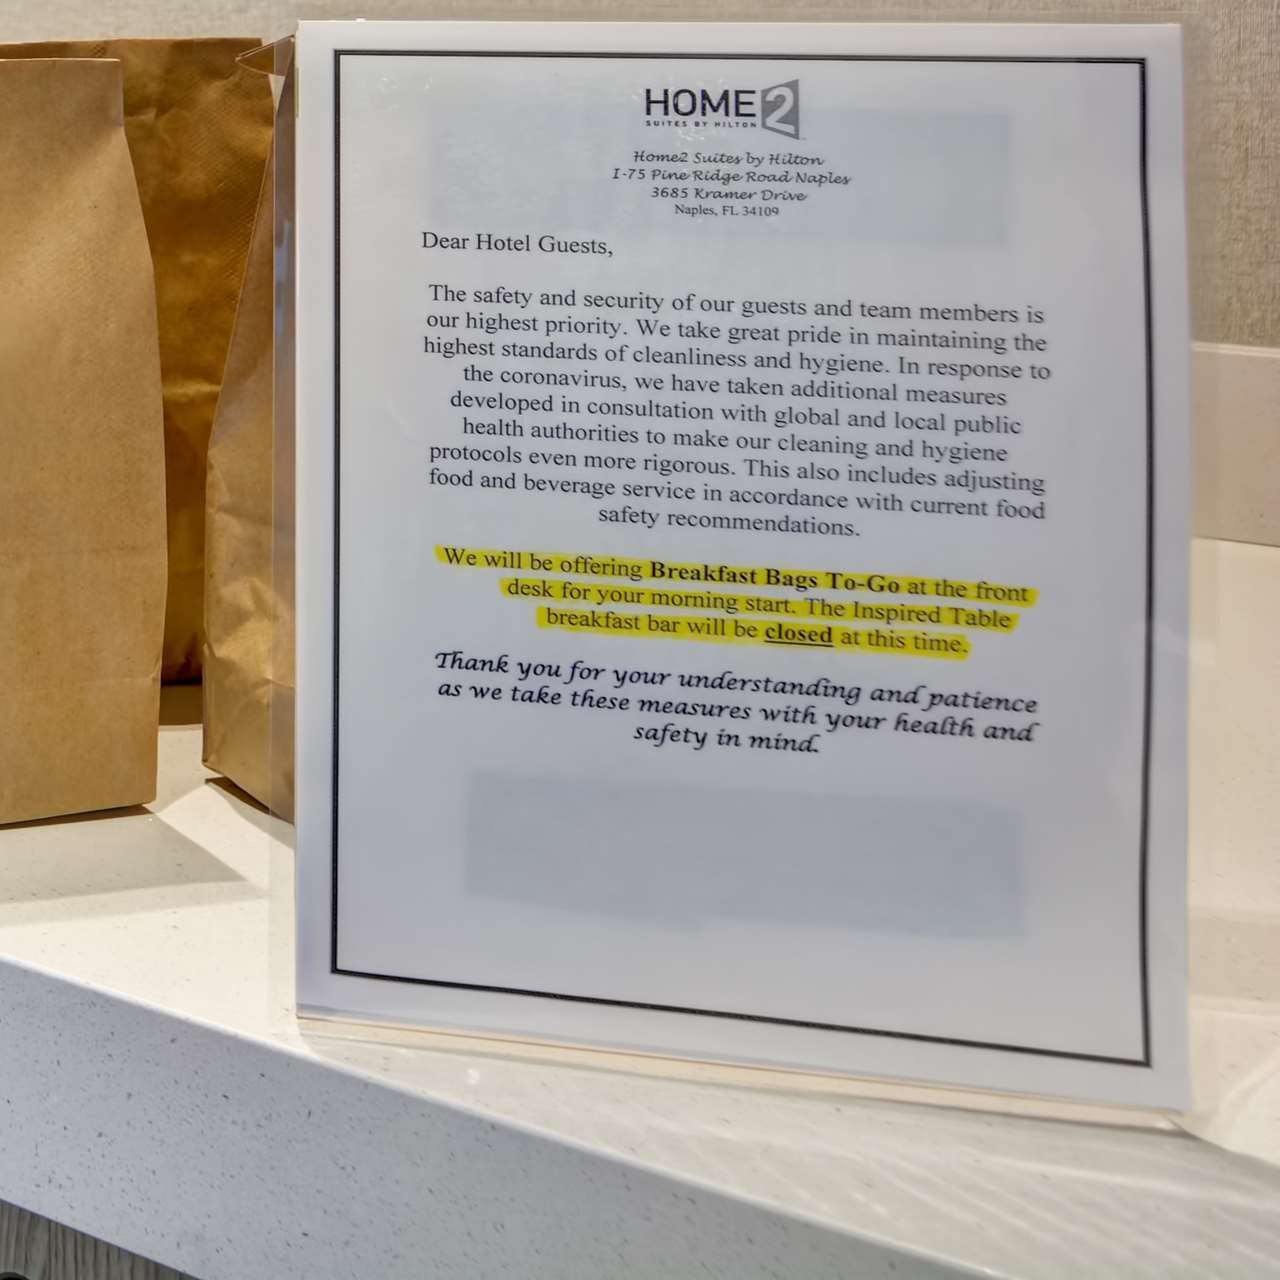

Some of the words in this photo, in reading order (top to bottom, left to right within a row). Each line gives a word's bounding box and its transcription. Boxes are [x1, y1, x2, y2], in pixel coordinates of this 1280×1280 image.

[645, 120, 687, 128] SUITES
[694, 120, 708, 128] BY
[714, 121, 757, 129] HILTON
[612, 167, 646, 180] I-75
[651, 169, 690, 181] Pine
[693, 170, 743, 184] Ridge
[745, 170, 794, 183] Road
[795, 171, 851, 187] Naples
[633, 150, 688, 163] Home2
[692, 152, 744, 165] Suites
[745, 152, 765, 168] by
[769, 153, 825, 166] Hilton
[651, 186, 688, 199] 3685
[693, 187, 757, 200] Kramer
[760, 189, 807, 201] Drive
[675, 204, 718, 217] Naples,
[722, 205, 739, 216] FL
[742, 206, 779, 216] 34109
[422, 231, 470, 250] Dear
[475, 233, 531, 252] Hotel
[538, 235, 613, 258] Guests,
[428, 284, 467, 302] The
[473, 286, 533, 309] safety
[539, 289, 577, 307] and
[583, 291, 664, 314] security
[672, 293, 696, 311] of
[699, 299, 736, 312] our
[741, 300, 807, 318] guests
[814, 299, 852, 317] and
[859, 303, 912, 319] team
[920, 304, 1019, 323] members
[1027, 305, 1044, 324] is
[426, 315, 460, 328] our
[465, 311, 539, 335] highest
[545, 315, 628, 339] priority.
[635, 318, 671, 337] We
[677, 320, 721, 339] take
[727, 327, 780, 345] great
[787, 325, 842, 347] pride
[849, 326, 869, 345] in
[877, 329, 1008, 355] maintaining
[1014, 333, 1047, 352] the
[424, 336, 495, 359] highest
[501, 341, 598, 361] standards
[604, 344, 630, 362] of
[633, 345, 747, 367] cleanliness
[754, 351, 791, 369] and
[799, 352, 890, 376] hygiene.
[899, 356, 920, 374] In
[928, 362, 1022, 381] response
[1029, 365, 1051, 380] to
[463, 364, 494, 382] the
[500, 369, 627, 392] coronavirus,
[634, 377, 664, 390] we
[671, 373, 720, 393] have
[727, 377, 784, 396] taken
[790, 379, 897, 401] additional
[906, 389, 1007, 406] measures
[450, 390, 554, 415] developed
[561, 395, 581, 414] in
[587, 399, 714, 420] consultation
[720, 404, 767, 423] with
[774, 406, 840, 428] global
[847, 410, 886, 428] and
[894, 411, 945, 431] local
[954, 415, 1021, 436] public
[463, 416, 524, 437] health
[530, 422, 639, 443] authorities
[646, 429, 666, 445] to
[672, 429, 729, 448] make
[736, 436, 772, 450] our
[777, 433, 869, 460] cleaning
[875, 439, 914, 457] and
[922, 440, 1008, 464] hygiene
[430, 445, 522, 464] protocols
[528, 452, 577, 467] even
[584, 455, 636, 470] more
[643, 453, 736, 477] rigorous.
[743, 459, 790, 479] This
[797, 462, 840, 481] also
[848, 464, 937, 486] includes
[944, 470, 1046, 496] adjusting
[429, 467, 473, 487] food
[480, 472, 516, 489] and
[523, 473, 616, 500] beverage
[622, 481, 696, 500] service
[704, 483, 722, 502] in
[729, 488, 848, 508] accordance
[856, 492, 903, 511] with
[910, 500, 988, 516] current
[997, 499, 1045, 519] food
[598, 505, 660, 529] safety
[667, 514, 860, 536] recommendations.
[443, 547, 477, 566] We
[483, 551, 522, 569] will
[529, 553, 553, 571] be
[560, 555, 643, 582] offering
[650, 561, 757, 584] Breakfast
[765, 568, 818, 593] Bags
[825, 572, 900, 594] To-Go
[907, 581, 927, 595] at
[935, 579, 968, 598] the
[976, 581, 1028, 602] front
[507, 578, 554, 598] desk
[562, 581, 591, 600] for
[596, 589, 645, 606] your
[651, 591, 739, 615] morning
[745, 597, 796, 614] start.
[804, 597, 846, 617] The
[854, 601, 941, 625] Inspired
[948, 607, 1011, 628] Table
[546, 607, 640, 630] breakfast
[647, 614, 681, 633] bar
[687, 617, 725, 636] will
[734, 619, 758, 638] be
[763, 623, 835, 644] closed
[841, 631, 860, 645] at
[867, 629, 906, 648] this
[913, 632, 968, 653] time.
[434, 650, 509, 674] Thank
[516, 662, 561, 682] you
[568, 660, 607, 685] for
[612, 669, 672, 689] your
[678, 670, 862, 706] understanding
[870, 685, 927, 705] and
[922, 690, 1038, 714] patience
[438, 683, 463, 697] as
[468, 685, 502, 700] we
[511, 685, 562, 705] take
[571, 689, 630, 711] these
[637, 699, 752, 720] measures
[759, 705, 817, 725] with
[825, 713, 887, 733] your
[893, 712, 975, 738] health
[983, 722, 1040, 742] and
[633, 723, 708, 751] safety
[717, 728, 742, 747] in
[748, 733, 821, 753] mind.
